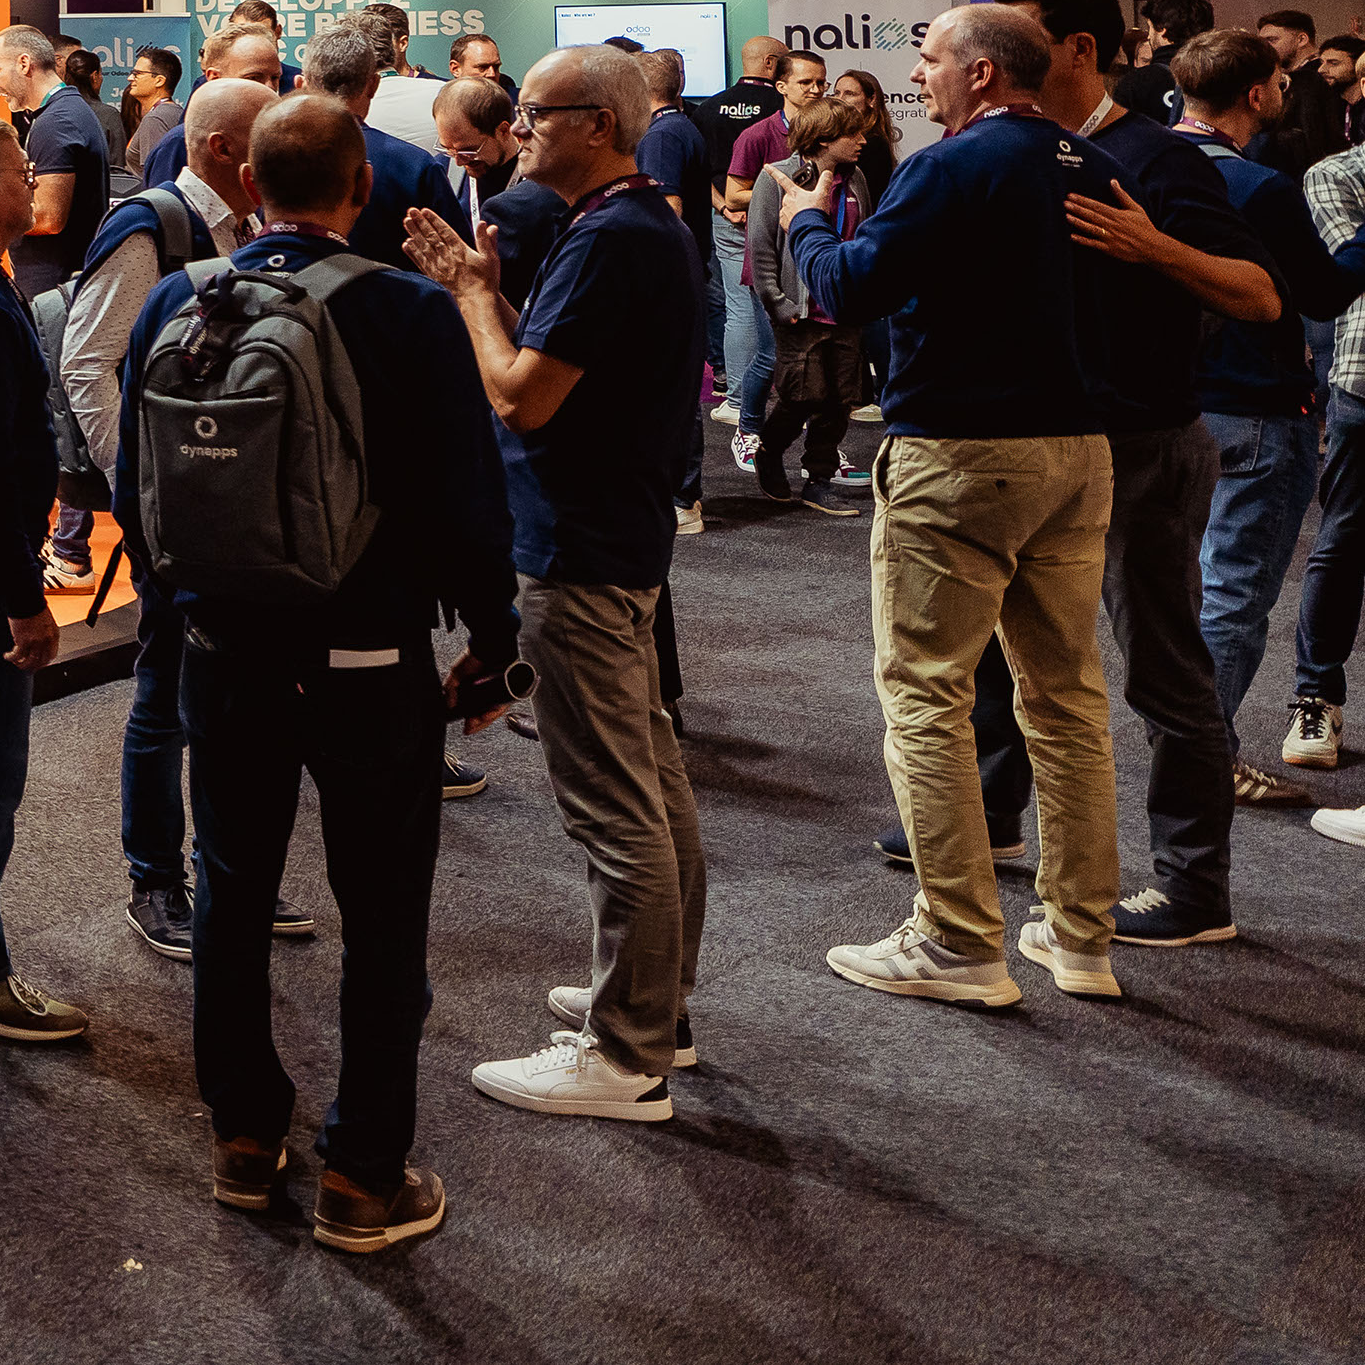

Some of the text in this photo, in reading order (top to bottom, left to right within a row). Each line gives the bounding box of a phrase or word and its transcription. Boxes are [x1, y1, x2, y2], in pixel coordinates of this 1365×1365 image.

[626, 25, 651, 33] odoo
[784, 13, 931, 51] nalios
[719, 102, 761, 115] nalios
[1056, 152, 1084, 163] dynapps
[604, 182, 630, 197] odoo
[179, 444, 238, 459] dynapps
